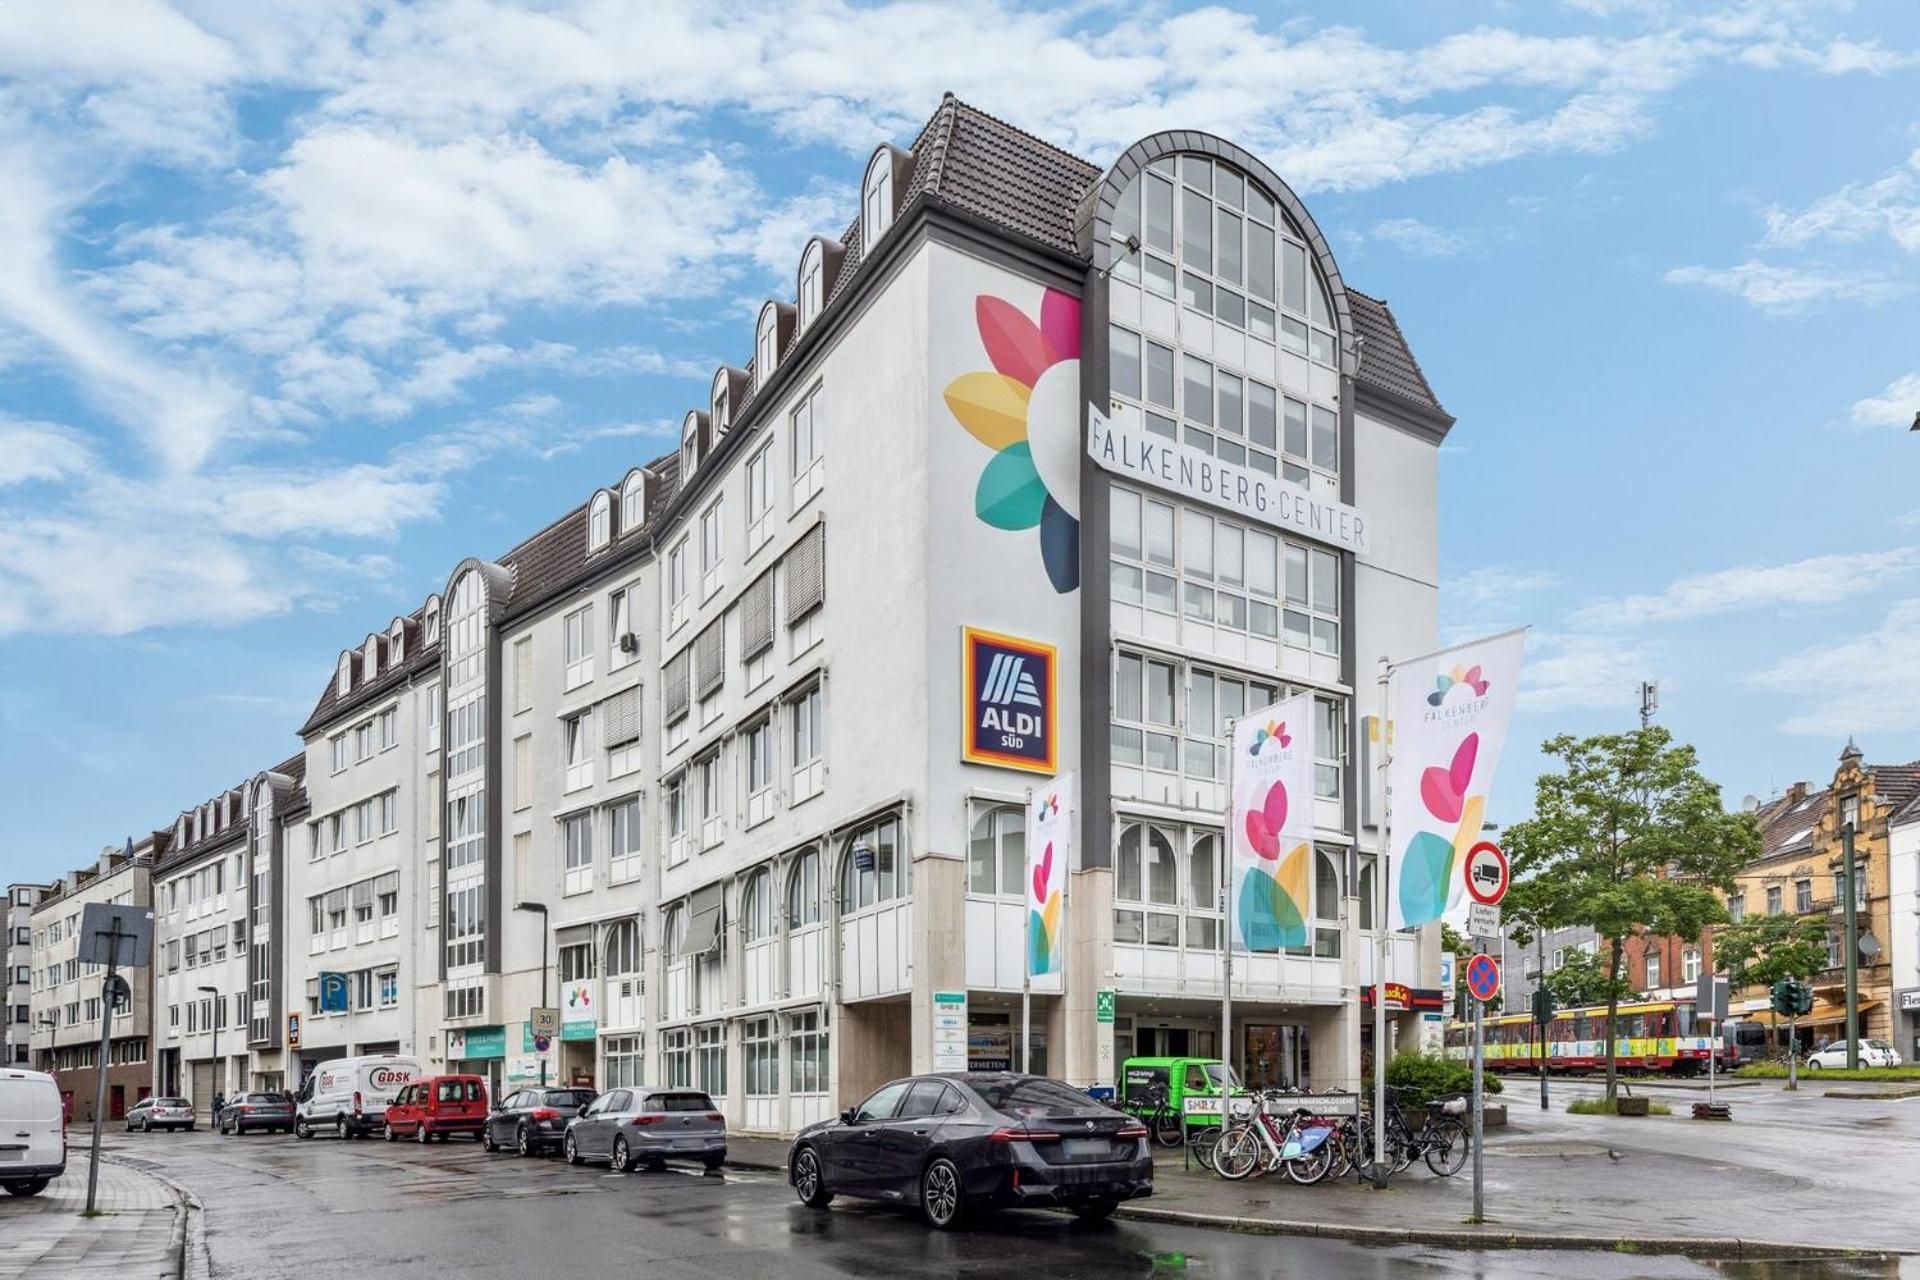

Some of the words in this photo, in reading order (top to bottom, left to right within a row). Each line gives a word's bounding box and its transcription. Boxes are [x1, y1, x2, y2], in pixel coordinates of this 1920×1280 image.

[981, 707, 1042, 738] ALDI
[1001, 733, 1023, 749] SÜD
[539, 1014, 551, 1024] 30
[968, 1060, 1007, 1070] ERMIETEN!
[377, 1072, 411, 1083] GDSK
